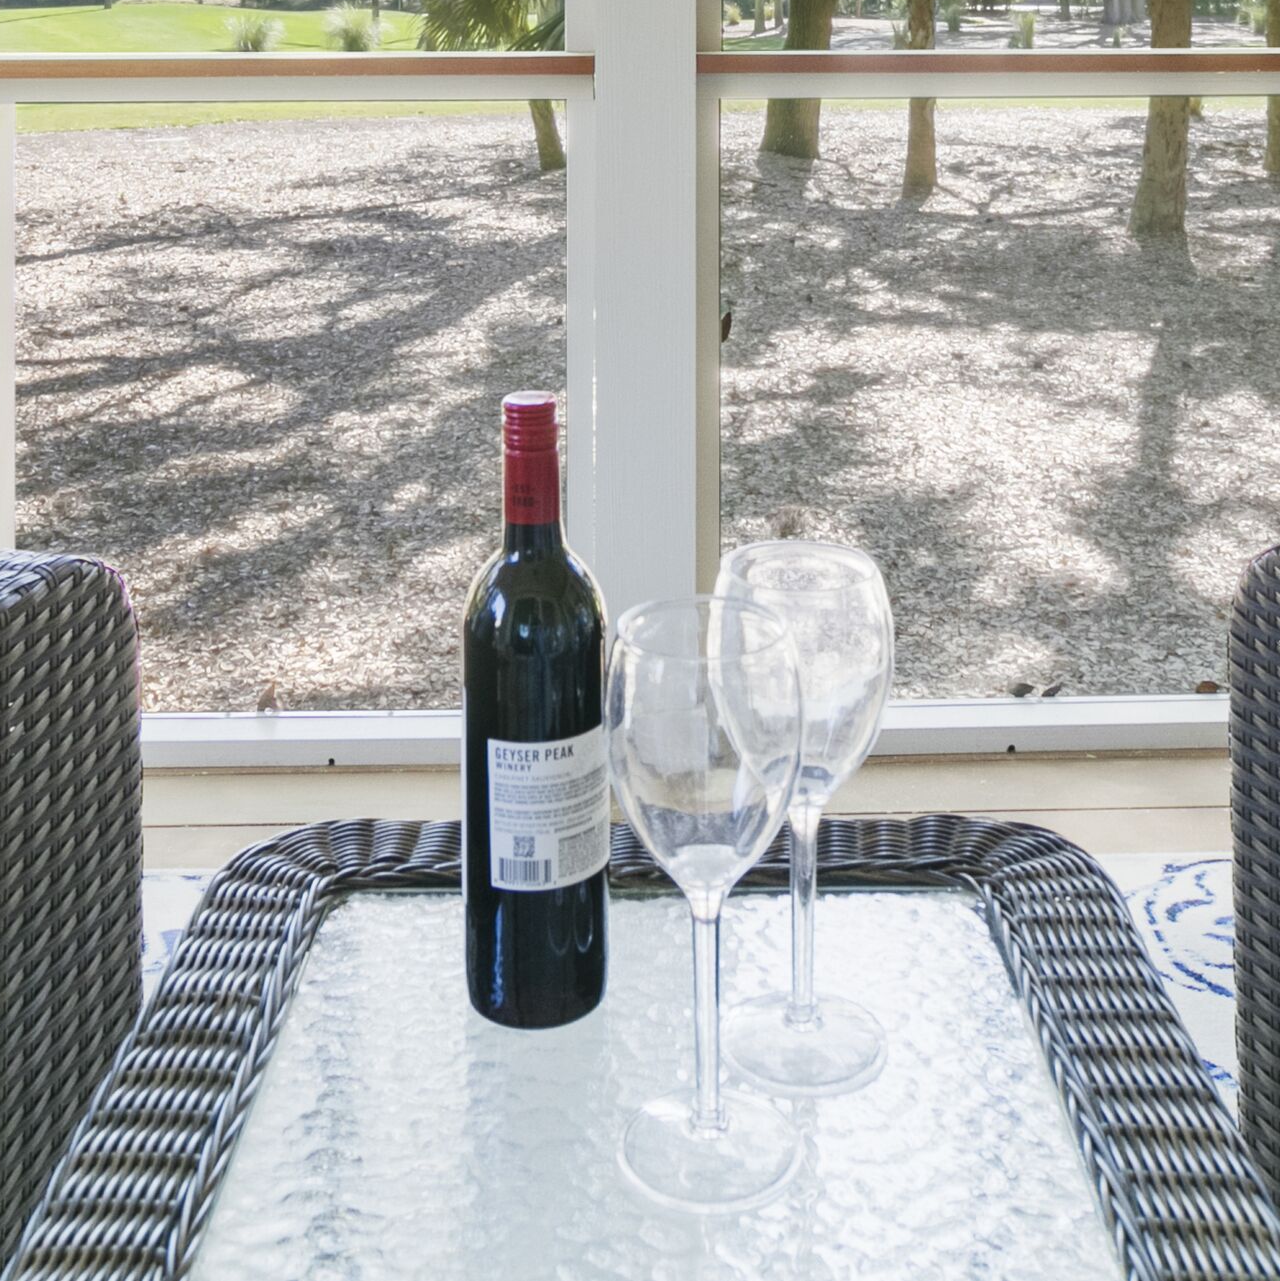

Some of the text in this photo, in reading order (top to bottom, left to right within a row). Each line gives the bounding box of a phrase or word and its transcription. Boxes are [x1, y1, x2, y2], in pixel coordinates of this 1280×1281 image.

[495, 744, 574, 762] GEYSER PEAK
[496, 762, 532, 772] WINERY
